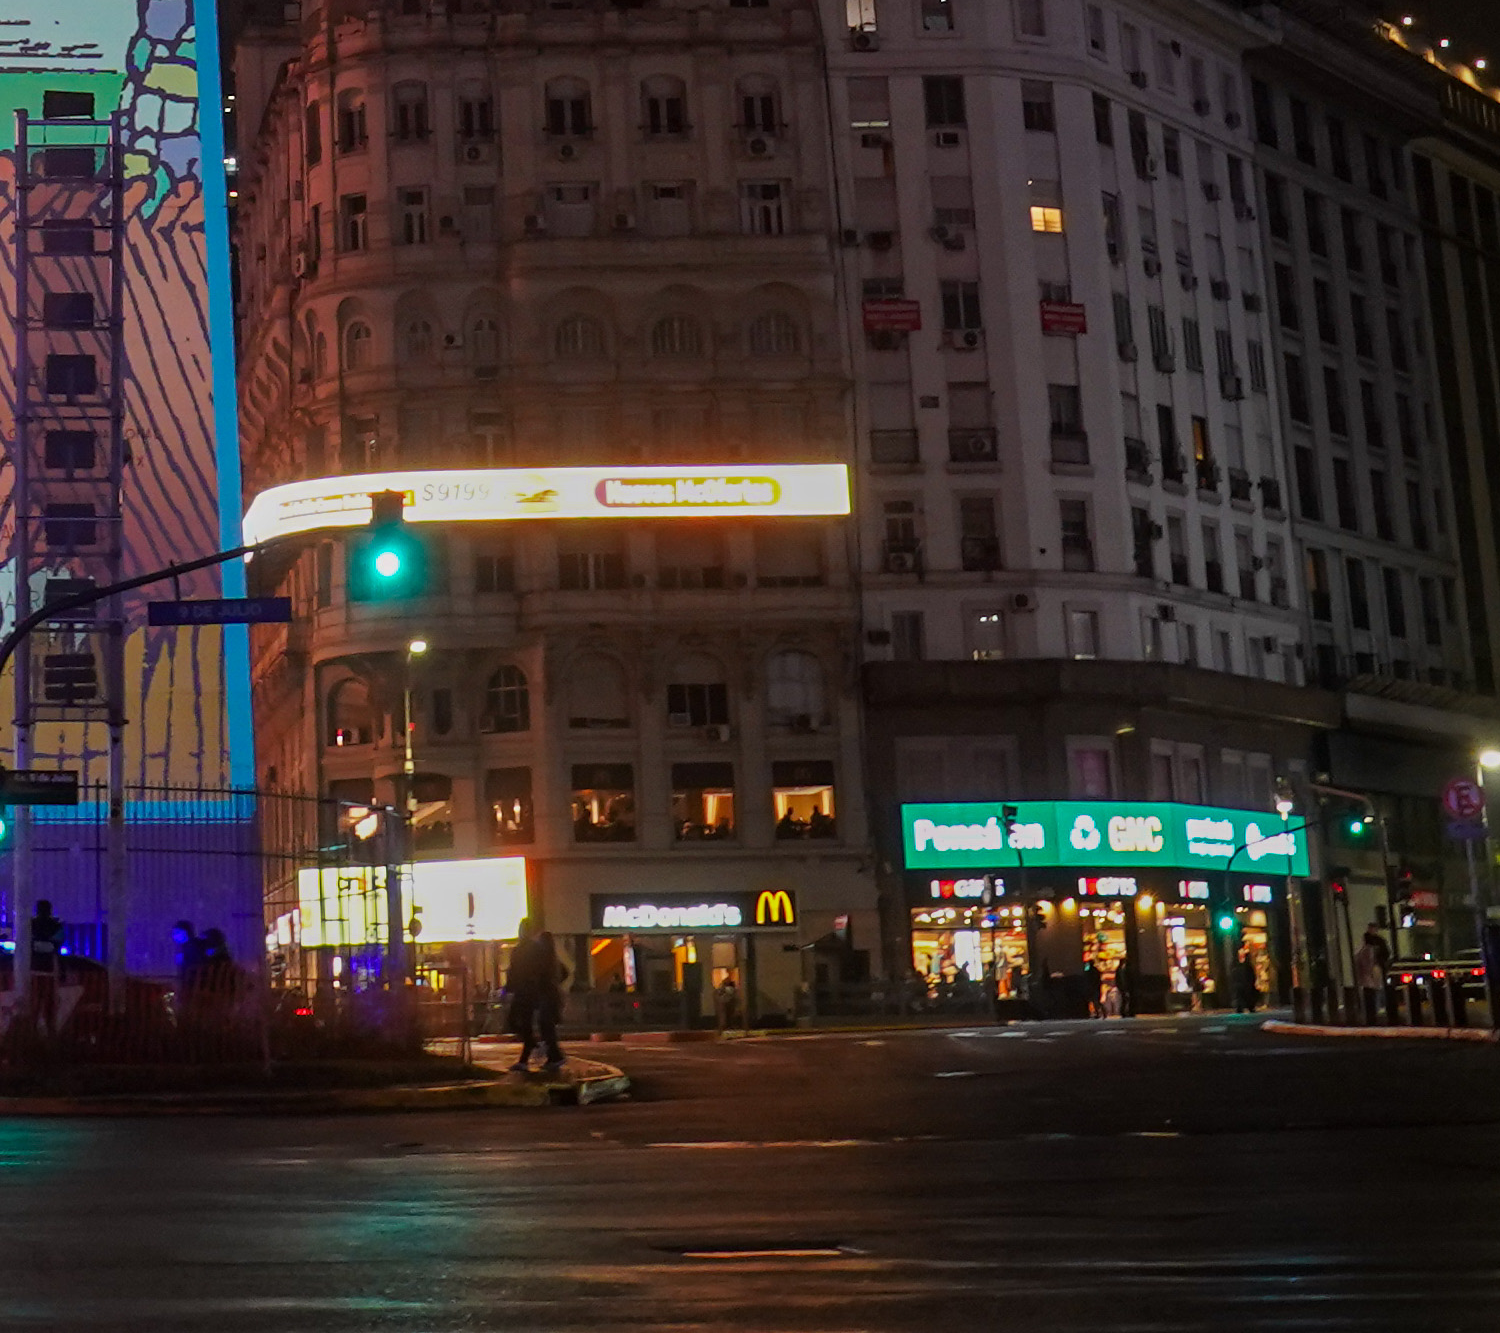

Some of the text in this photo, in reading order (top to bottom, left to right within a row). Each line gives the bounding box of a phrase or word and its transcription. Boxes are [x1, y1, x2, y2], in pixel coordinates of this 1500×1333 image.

[192, 604, 212, 618] DE
[218, 602, 261, 617] JULIO
[1107, 815, 1164, 852] GNC
[602, 903, 742, 928] McDonald's
